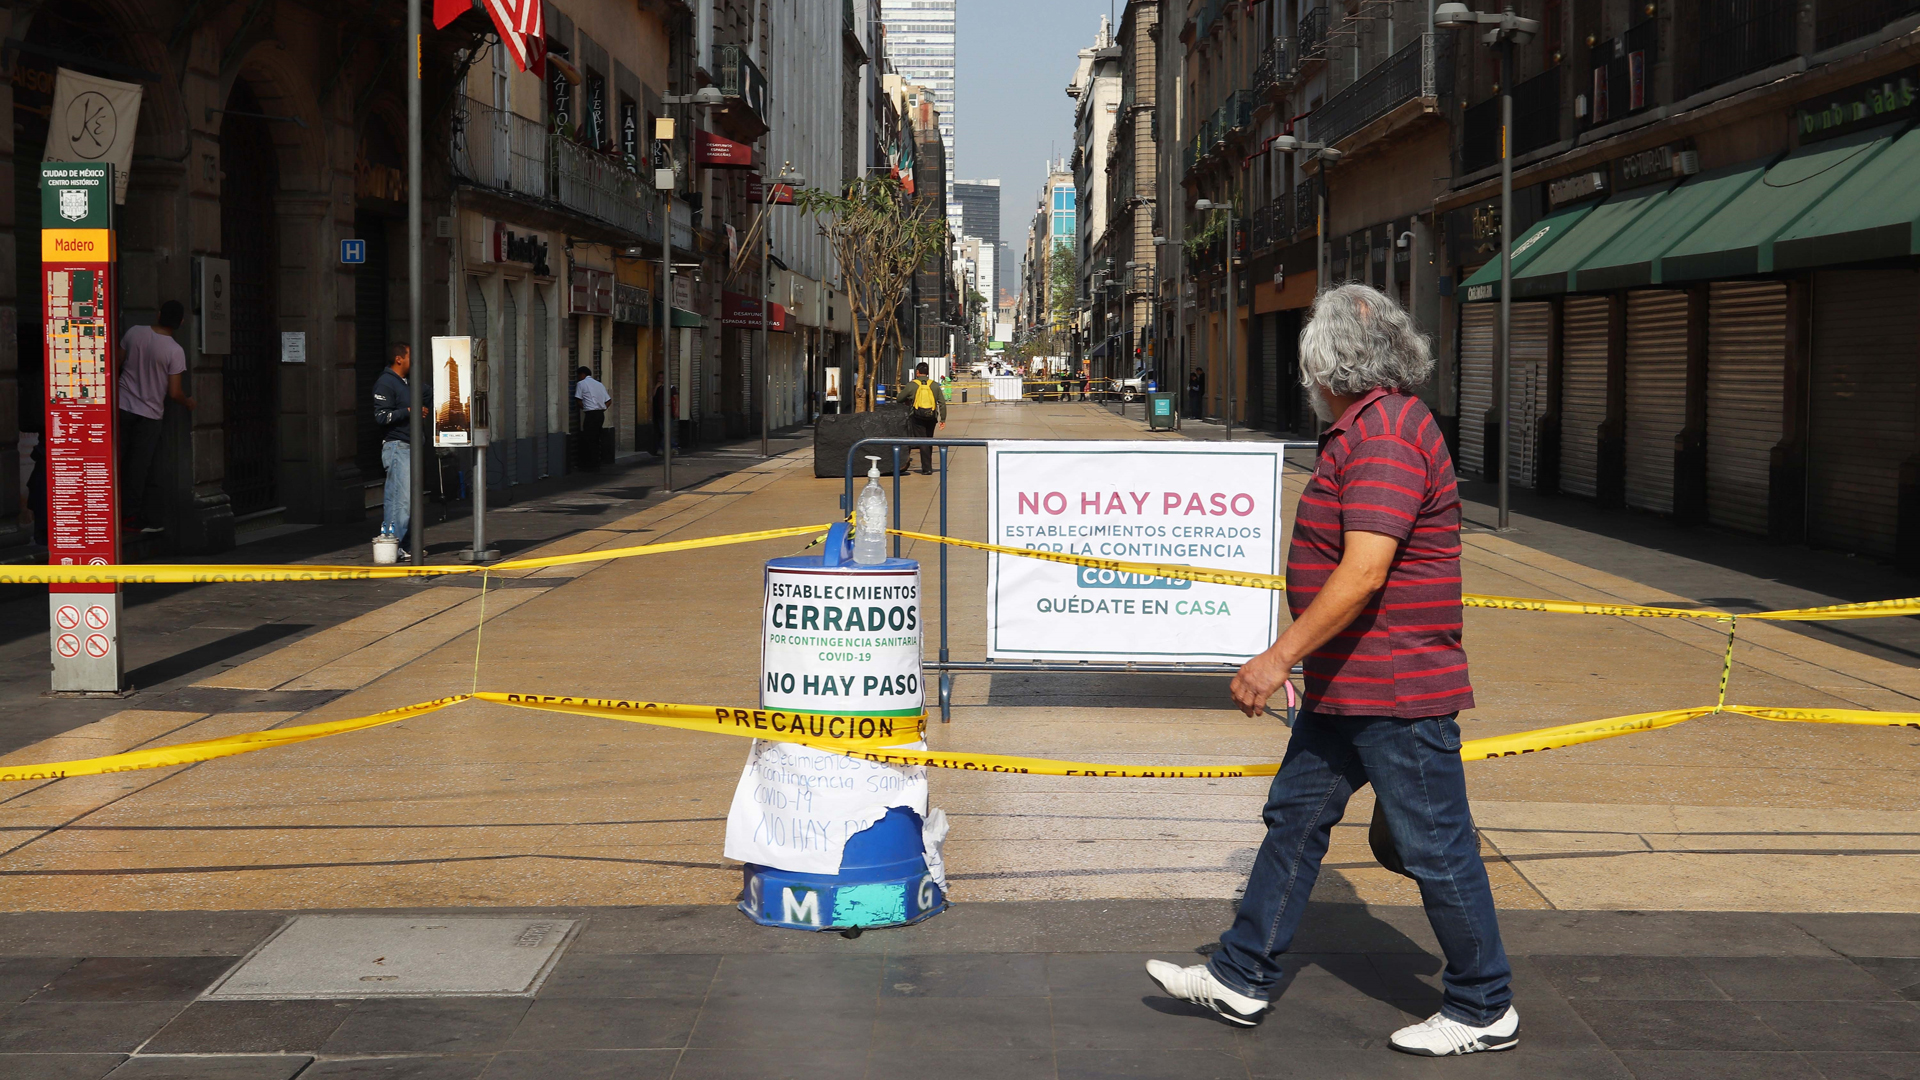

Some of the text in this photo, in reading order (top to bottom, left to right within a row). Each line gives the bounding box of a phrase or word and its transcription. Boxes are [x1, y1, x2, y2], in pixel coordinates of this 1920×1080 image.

[42, 168, 104, 178] CIUDAD DE MÉXICO
[70, 178, 99, 186] HISTÓRICO
[55, 238, 94, 251] Madero
[346, 243, 360, 260] H
[1018, 491, 1255, 517] NO HAY PASO
[1006, 525, 1262, 539] ESTABLECIMIENTOS CERRADOS
[1070, 542, 1093, 556] LA
[1100, 542, 1246, 558] CONTINGENCIA
[772, 583, 917, 600] ESTABLECIMIENTOS
[1036, 595, 1231, 616] QUÉDATE EN CASA
[772, 603, 917, 632] CERRADOS
[770, 633, 918, 647] POR CONTINGENCIA SANITARIA
[818, 652, 872, 662] COVID-19
[767, 671, 918, 697] NO HAY PASO
[715, 708, 893, 739] PRECAUCION
[753, 783, 813, 813] COVID-19
[754, 812, 786, 847] NO
[792, 817, 832, 853] HAY
[782, 886, 821, 927] M
